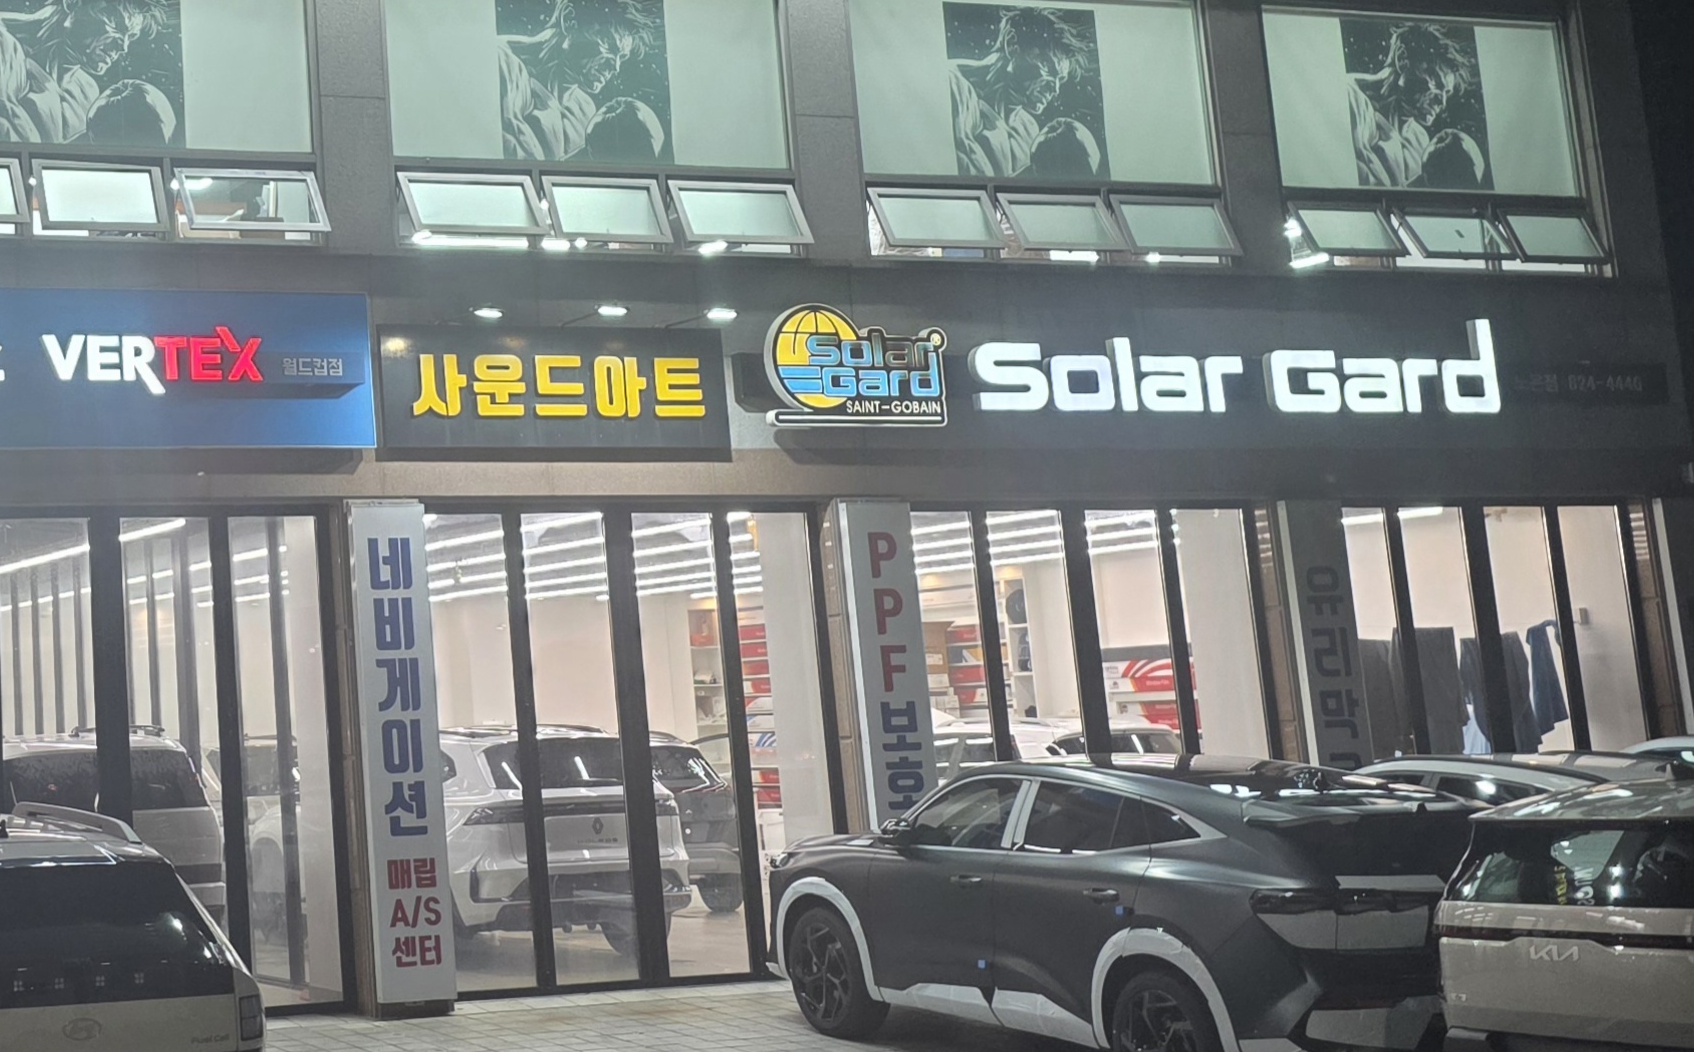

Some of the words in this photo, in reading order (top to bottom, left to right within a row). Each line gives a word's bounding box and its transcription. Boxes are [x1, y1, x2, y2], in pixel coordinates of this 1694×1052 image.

[41, 325, 264, 395] VERTEX
[282, 356, 343, 377] 월드컵점
[807, 333, 934, 367] Solar
[969, 336, 1243, 414] Solar
[1262, 318, 1502, 416] Gard
[412, 352, 706, 418] 사운드아트
[821, 351, 940, 398] Gard
[846, 400, 941, 415] SAINT-GOBAIN
[367, 536, 428, 837] 네비게이션
[387, 856, 438, 891] 매립
[390, 895, 442, 929] A/S
[391, 933, 442, 969] 센터
[1529, 944, 1580, 962] KIA
